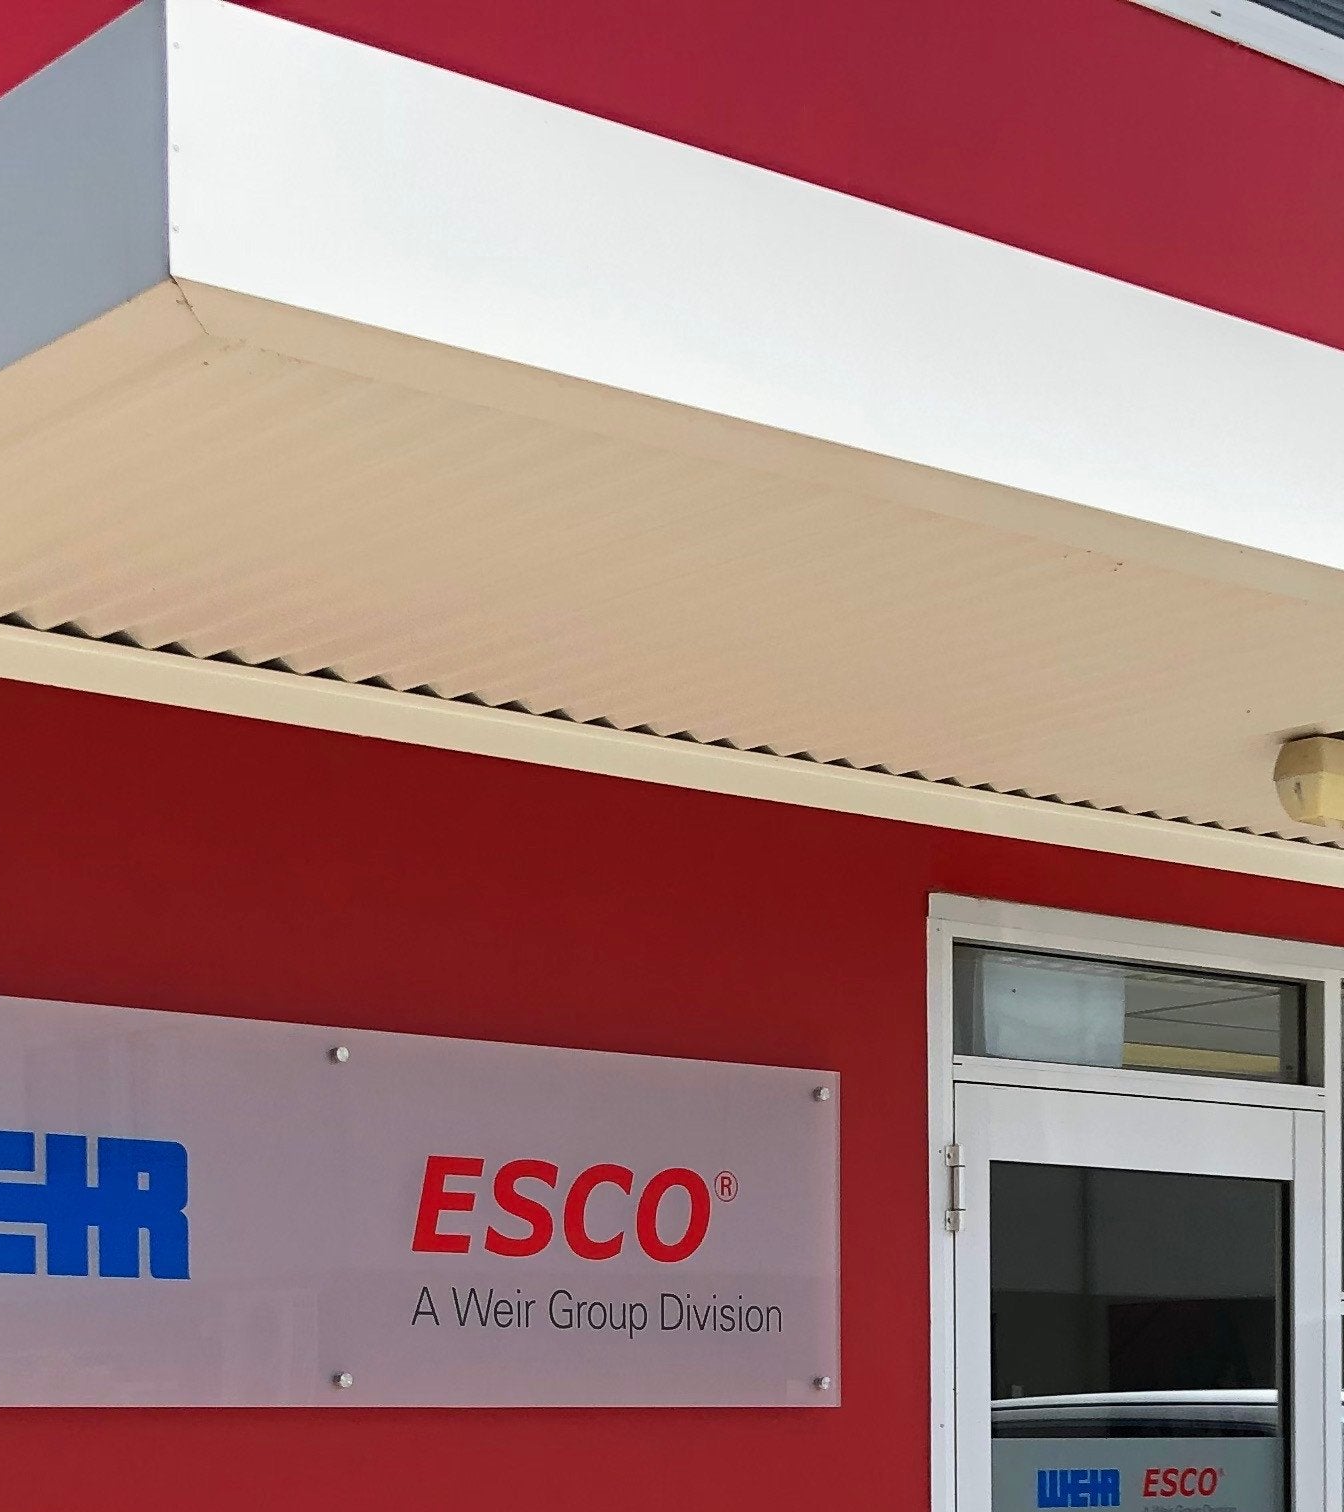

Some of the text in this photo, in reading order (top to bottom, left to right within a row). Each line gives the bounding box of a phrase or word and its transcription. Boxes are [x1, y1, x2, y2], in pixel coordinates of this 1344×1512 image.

[411, 1286, 782, 1340] A Weir Group Division
[1037, 1469, 1121, 1508] WEIR
